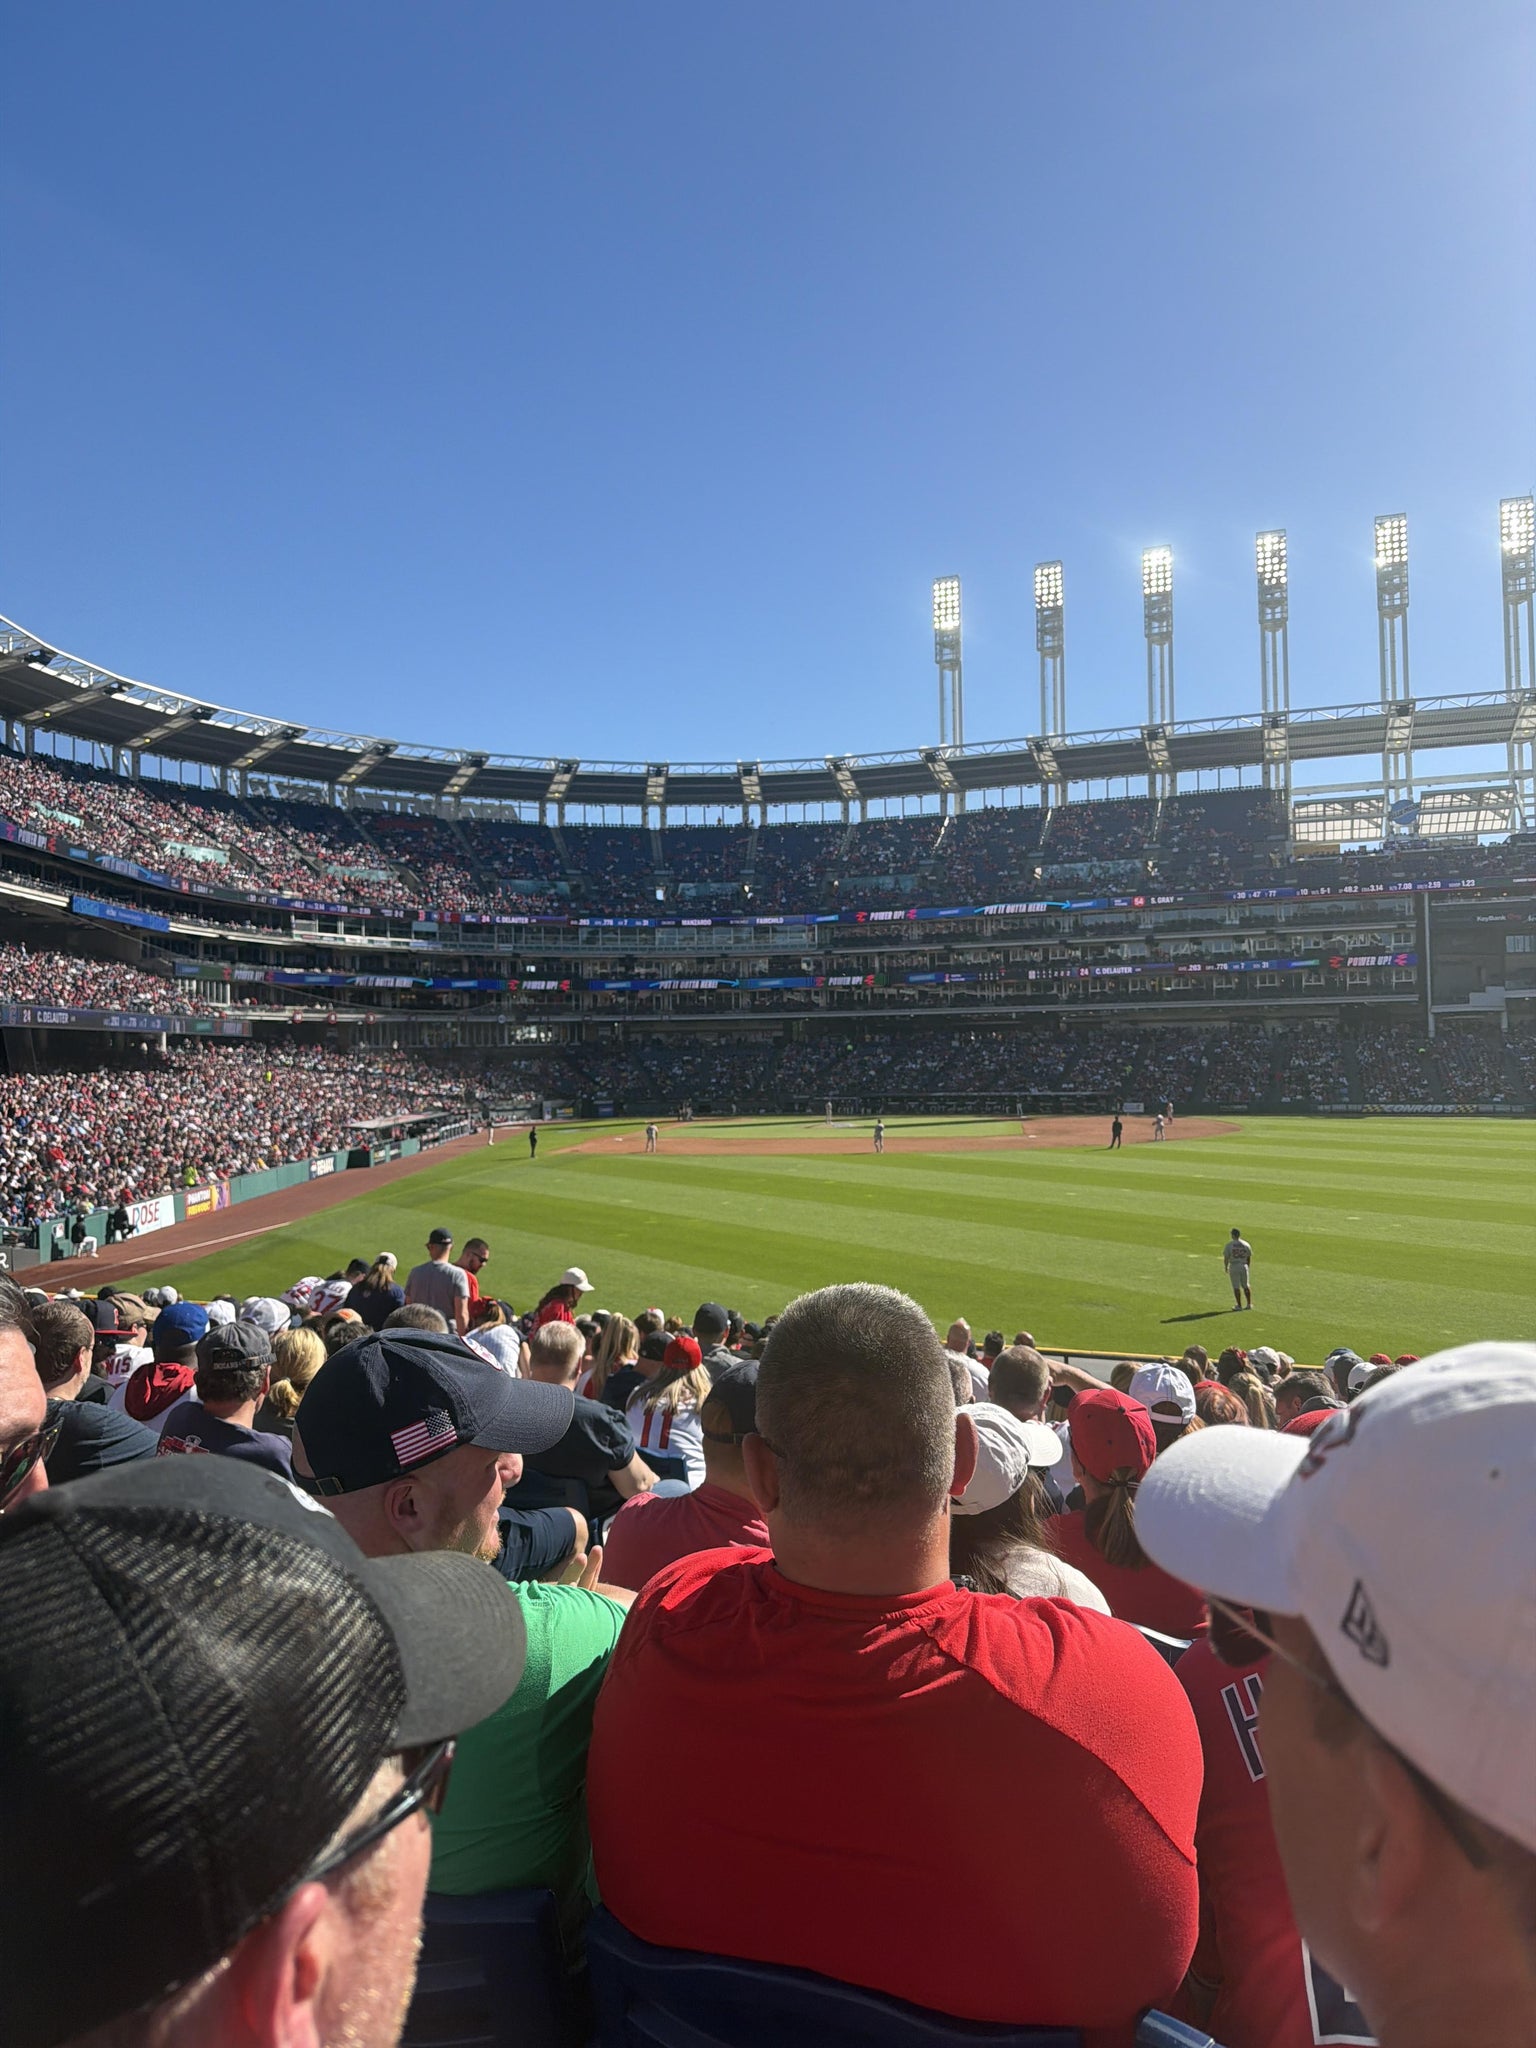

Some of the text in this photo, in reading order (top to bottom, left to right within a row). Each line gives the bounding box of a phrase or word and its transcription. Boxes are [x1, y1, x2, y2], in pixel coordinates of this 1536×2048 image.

[1158, 896, 1174, 904] GRAY
[870, 911, 892, 921] POWER
[1347, 955, 1392, 966] POWER UP!
[1102, 966, 1132, 974] DELAUTER
[43, 1011, 69, 1024] DELAUTER
[1384, 1104, 1454, 1113] CONRAD'S
[106, 1357, 132, 1375] NIS
[640, 1408, 674, 1450] 11
